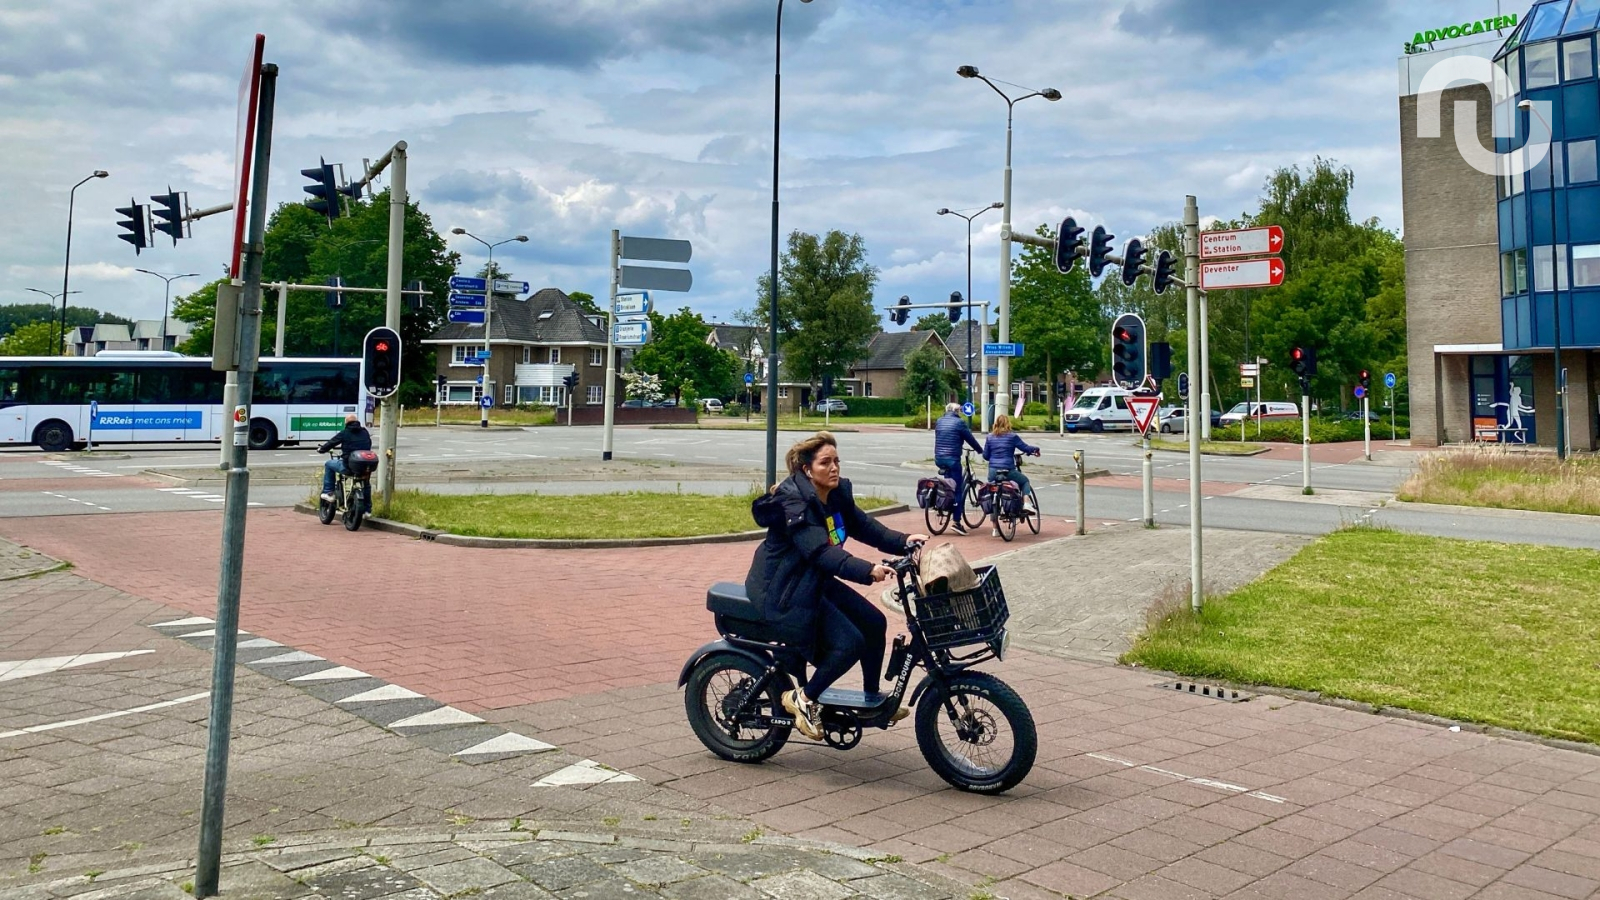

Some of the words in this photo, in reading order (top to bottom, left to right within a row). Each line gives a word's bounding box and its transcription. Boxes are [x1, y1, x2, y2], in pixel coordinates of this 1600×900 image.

[1412, 14, 1517, 45] ADVOCATEN
[1203, 234, 1237, 243] Centrum
[1213, 245, 1241, 253] Station
[1204, 265, 1239, 273] Deventer
[100, 416, 132, 424] RRReis
[900, 653, 912, 680] SOURIS
[950, 684, 990, 696] ENDA
